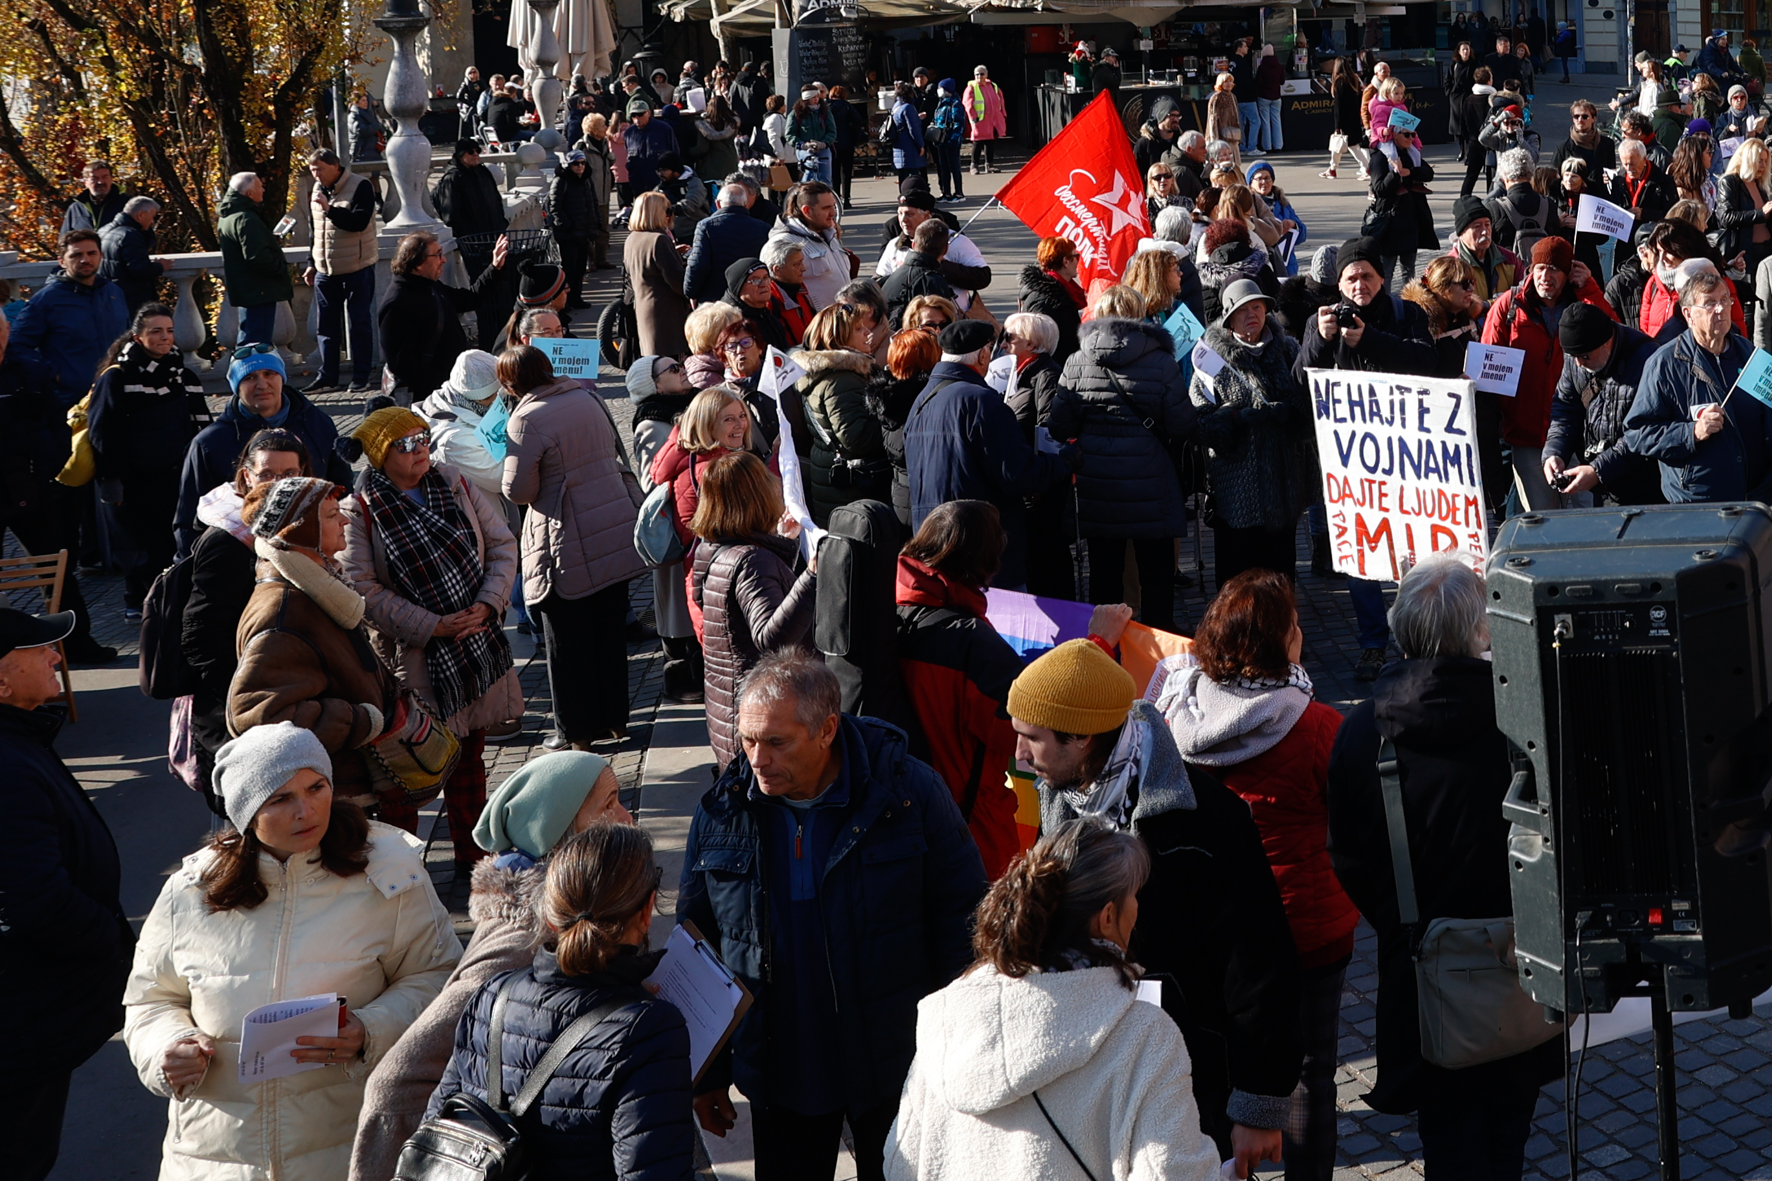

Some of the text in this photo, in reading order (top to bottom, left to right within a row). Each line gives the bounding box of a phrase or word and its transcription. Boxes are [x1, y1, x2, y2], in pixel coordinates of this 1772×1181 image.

[807, 0, 858, 10] ADMIRA
[1291, 99, 1336, 111] ADMIRA
[1595, 205, 1606, 214] NE
[552, 347, 563, 355] NE
[557, 356, 590, 366] mojem
[1484, 353, 1495, 362] NE
[553, 366, 583, 374] menu!
[1488, 364, 1514, 374] mojem
[1480, 370, 1507, 382] imenu!
[1313, 378, 1467, 437] NEHAJTE Z
[1333, 429, 1477, 488] VOJNAMI
[1326, 472, 1482, 530] DAJTE LJUDEM
[1331, 510, 1356, 567] PACE
